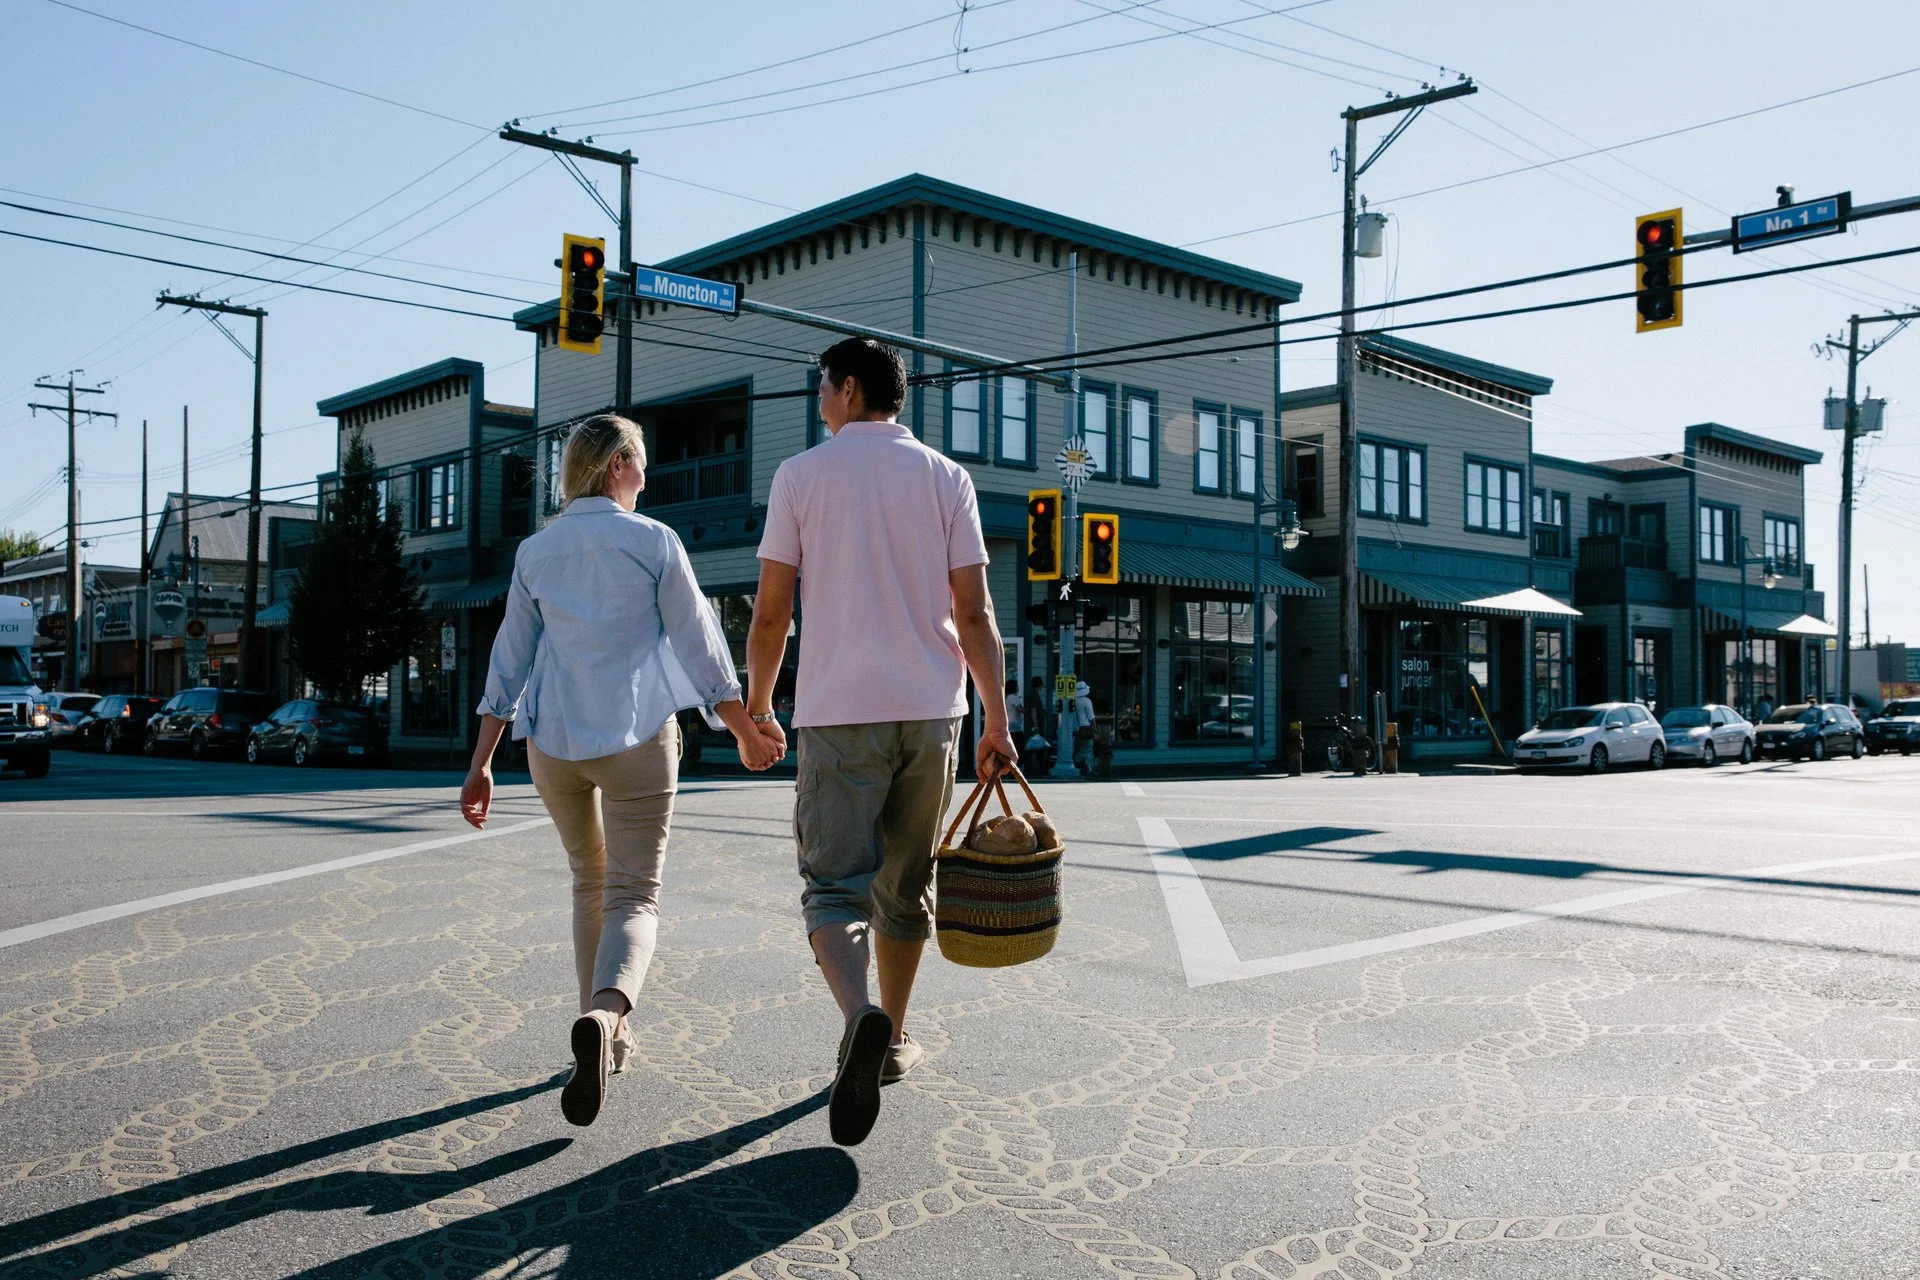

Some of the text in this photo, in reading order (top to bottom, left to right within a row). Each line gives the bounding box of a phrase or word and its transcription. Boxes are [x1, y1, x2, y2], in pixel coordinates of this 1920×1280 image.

[1766, 217, 1793, 233] No
[1799, 210, 1809, 226] 1
[654, 275, 718, 305] Moncton
[0, 624, 19, 633] TCH
[1402, 656, 1429, 672] salon
[1401, 674, 1433, 691] juniper
